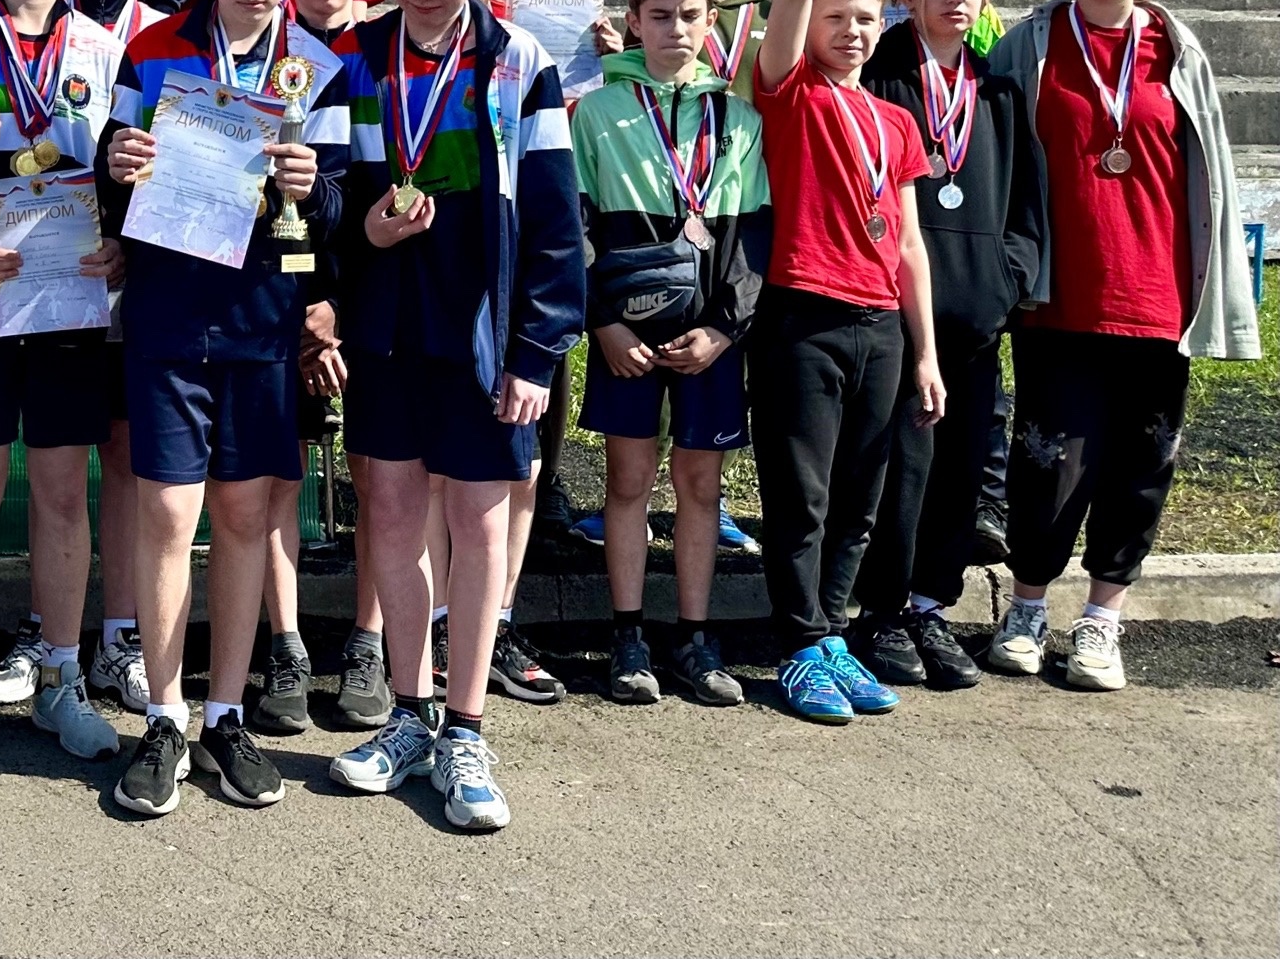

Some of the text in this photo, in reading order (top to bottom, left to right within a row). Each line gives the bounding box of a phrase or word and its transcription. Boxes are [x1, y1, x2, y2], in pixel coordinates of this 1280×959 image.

[174, 109, 252, 143] ДИПЛОМ
[5, 202, 76, 228] ДИПЛОМ
[628, 290, 668, 312] NIKE
